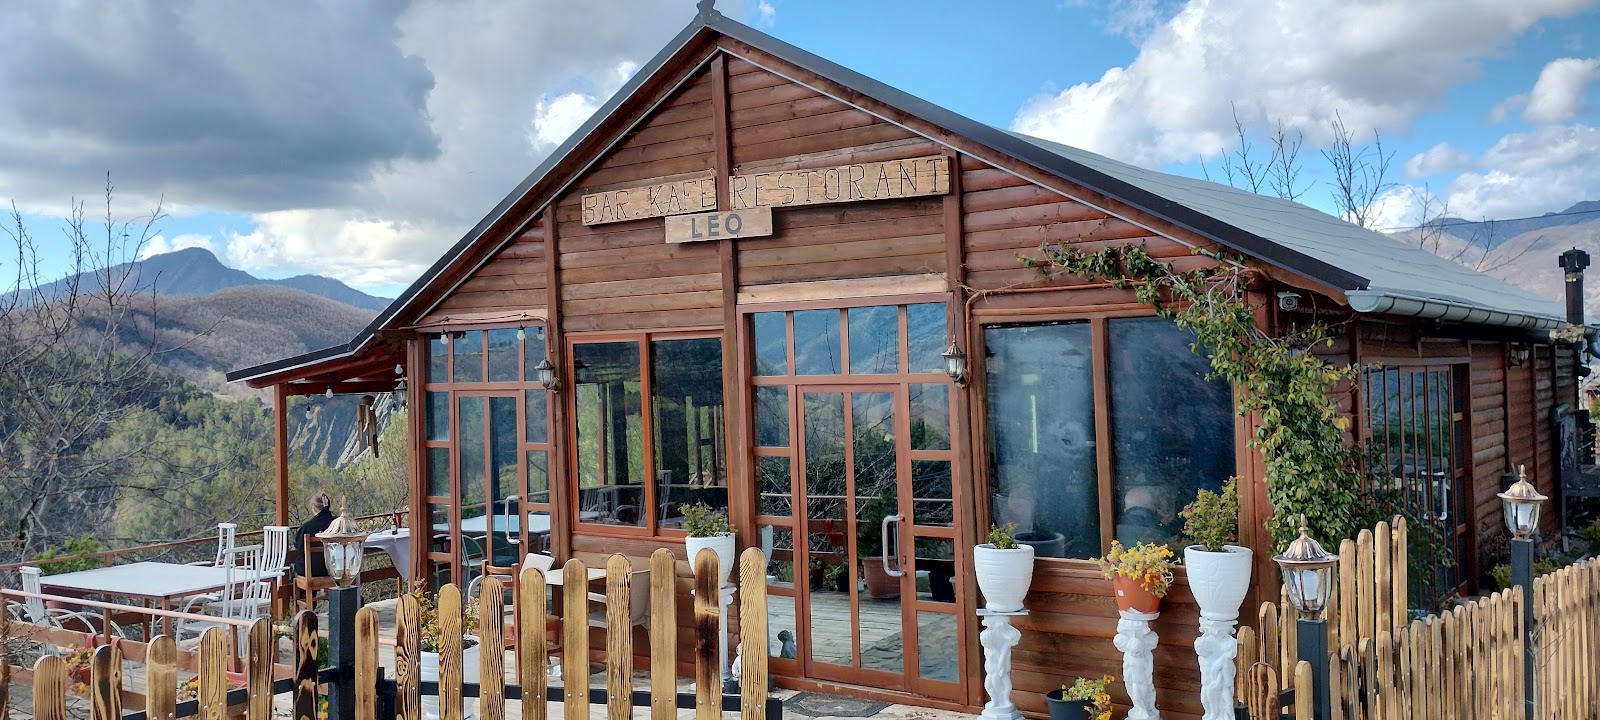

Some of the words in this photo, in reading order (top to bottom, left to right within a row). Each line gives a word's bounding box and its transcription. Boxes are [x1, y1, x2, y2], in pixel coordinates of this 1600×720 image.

[648, 178, 716, 216] KAFE
[731, 158, 943, 209] RESTORANT
[691, 213, 742, 239] LEO
